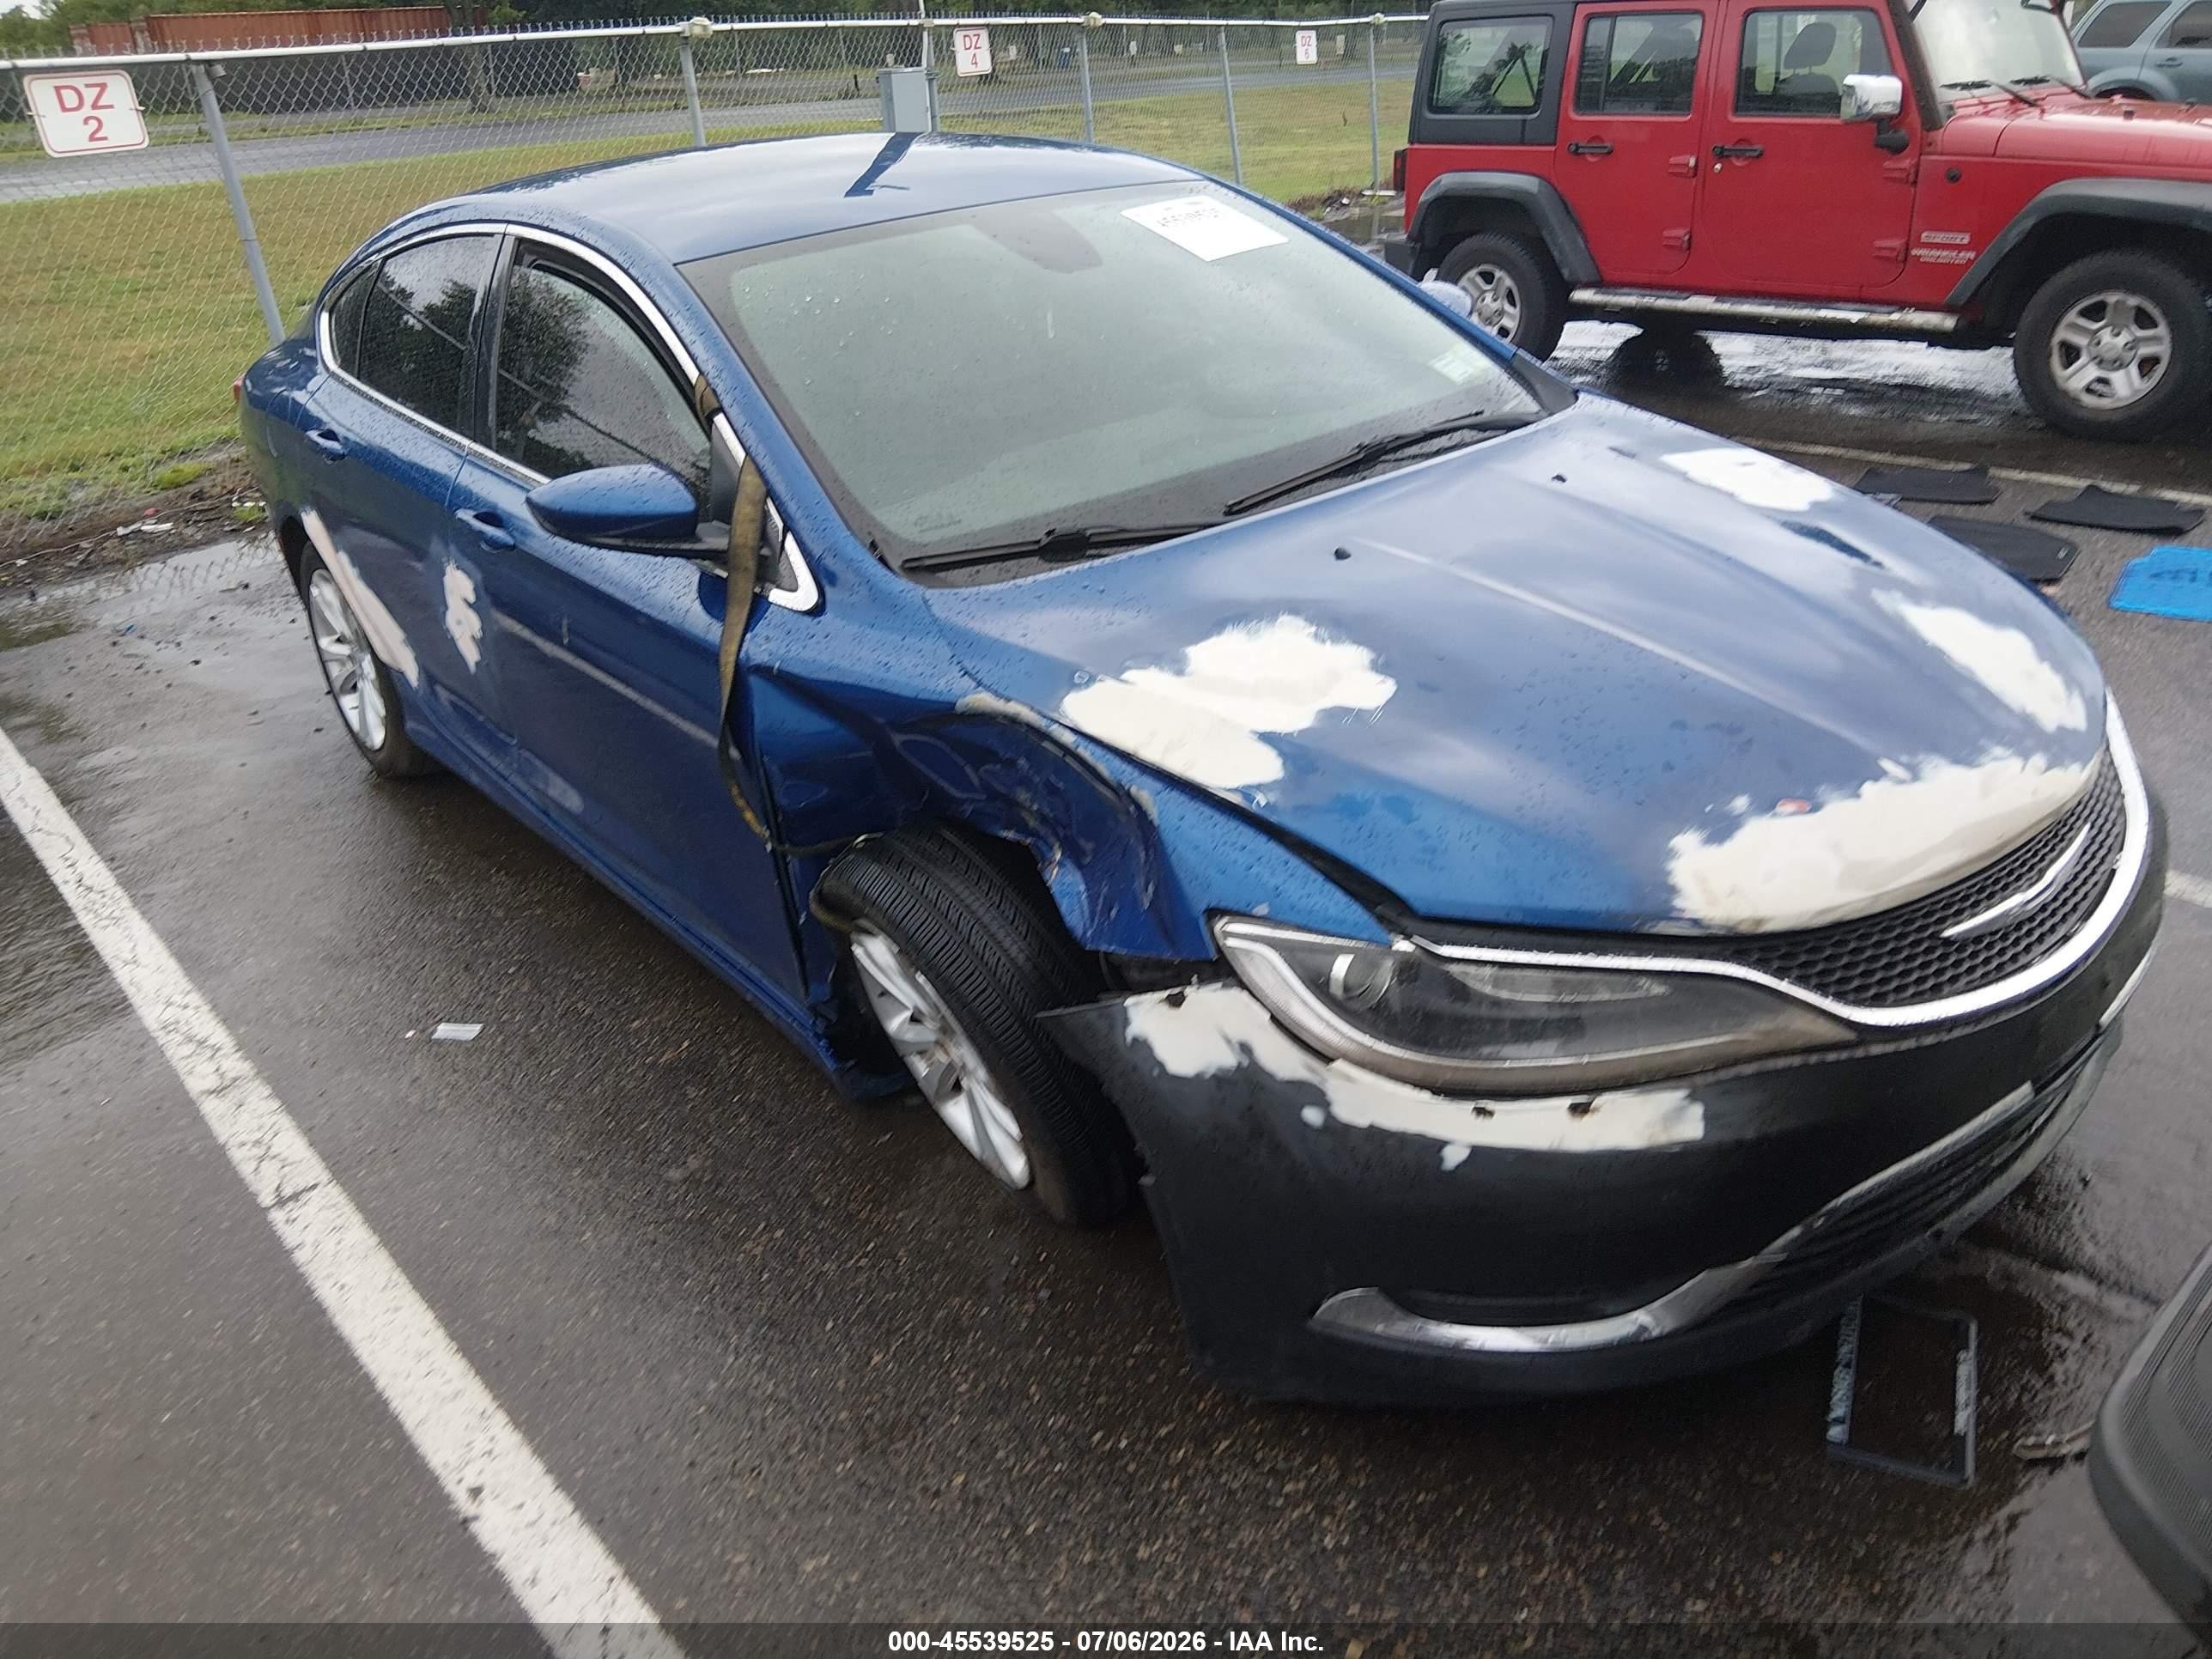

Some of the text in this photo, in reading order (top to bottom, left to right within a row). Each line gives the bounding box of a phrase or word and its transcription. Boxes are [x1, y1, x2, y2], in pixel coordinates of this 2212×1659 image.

[963, 34, 981, 50] DZ
[1301, 35, 1312, 47] DZ
[971, 53, 978, 69] 4
[53, 82, 114, 112] DZ
[83, 115, 108, 143] 2
[1922, 233, 1968, 243] SPORT
